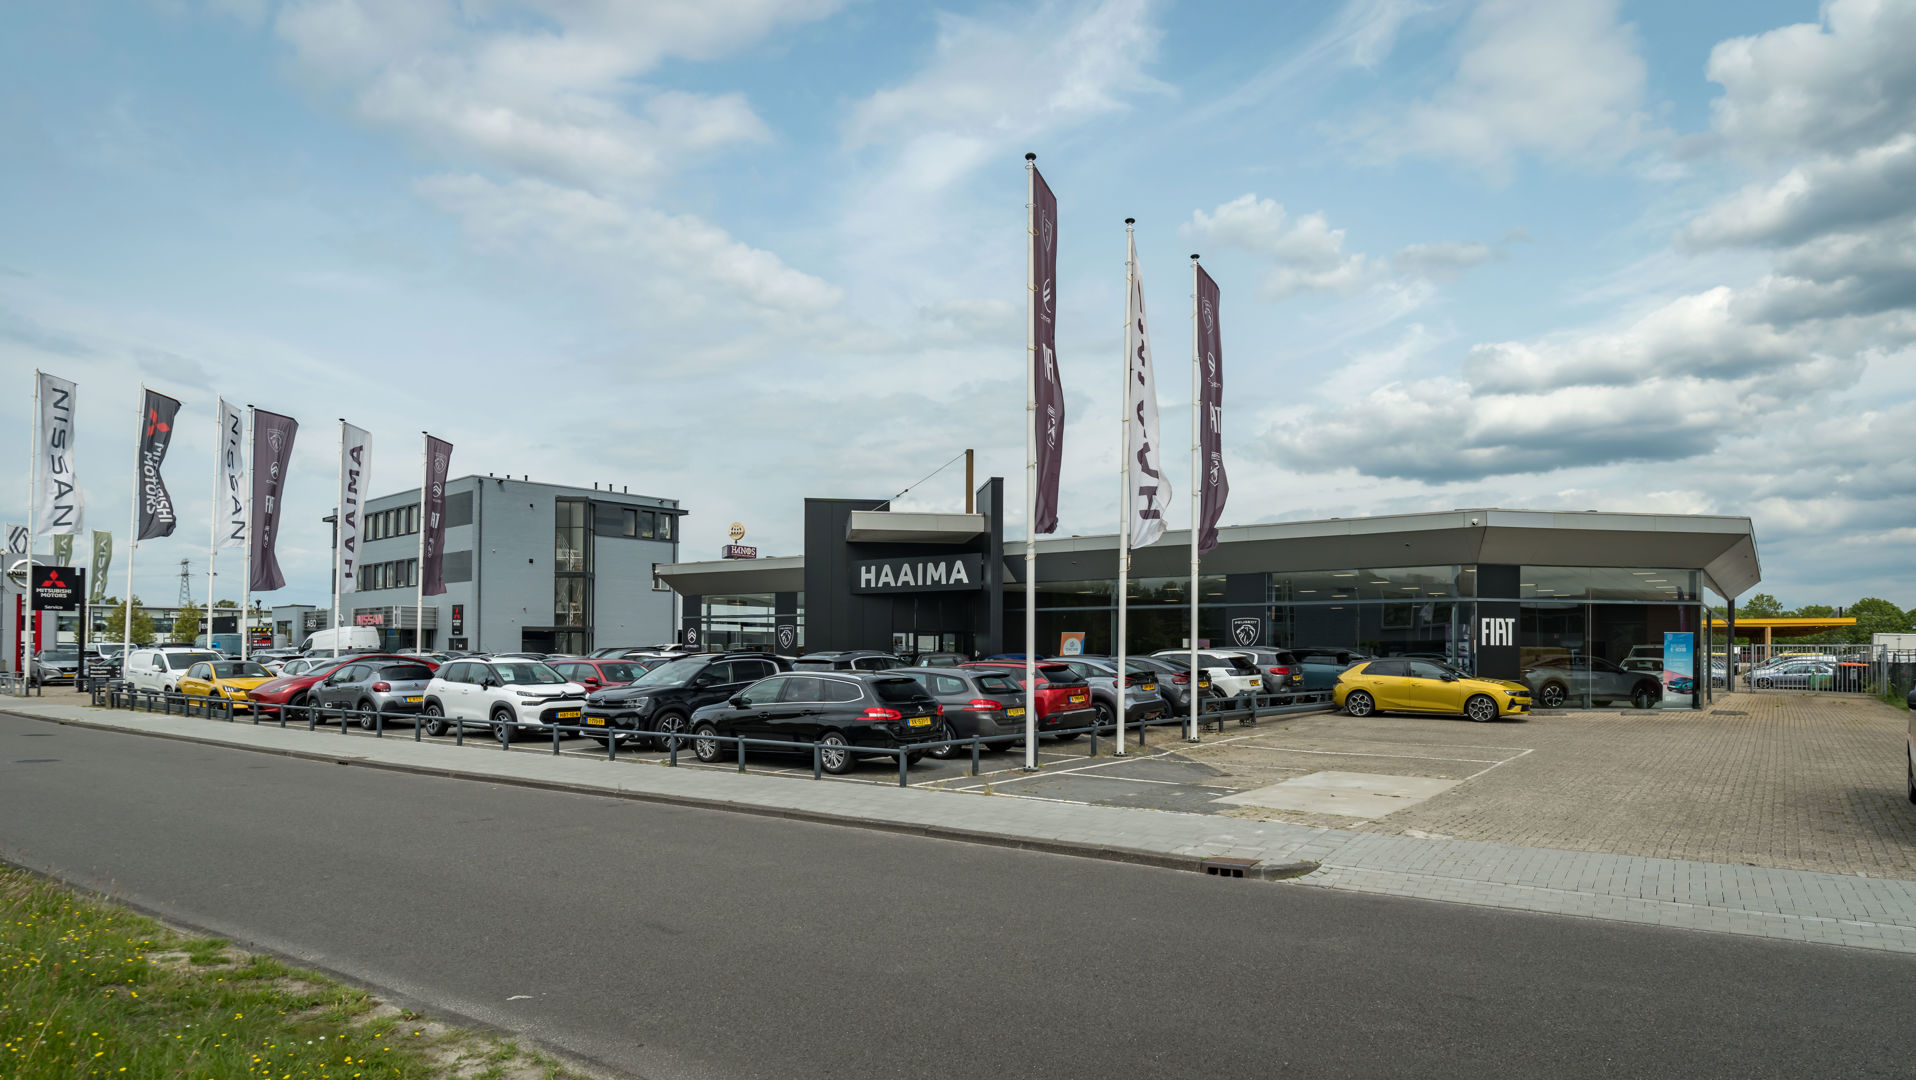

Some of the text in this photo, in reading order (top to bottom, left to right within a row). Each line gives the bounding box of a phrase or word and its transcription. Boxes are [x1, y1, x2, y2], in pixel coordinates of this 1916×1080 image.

[1209, 401, 1221, 434] AT
[51, 387, 74, 526] NISSAN
[227, 414, 246, 540] NISSAN
[143, 451, 158, 515] MOTORS
[344, 445, 363, 578] HAAIMA
[861, 560, 969, 588] HAAIMA
[356, 614, 384, 625] NISSAN
[1481, 617, 1515, 646] FIAT
